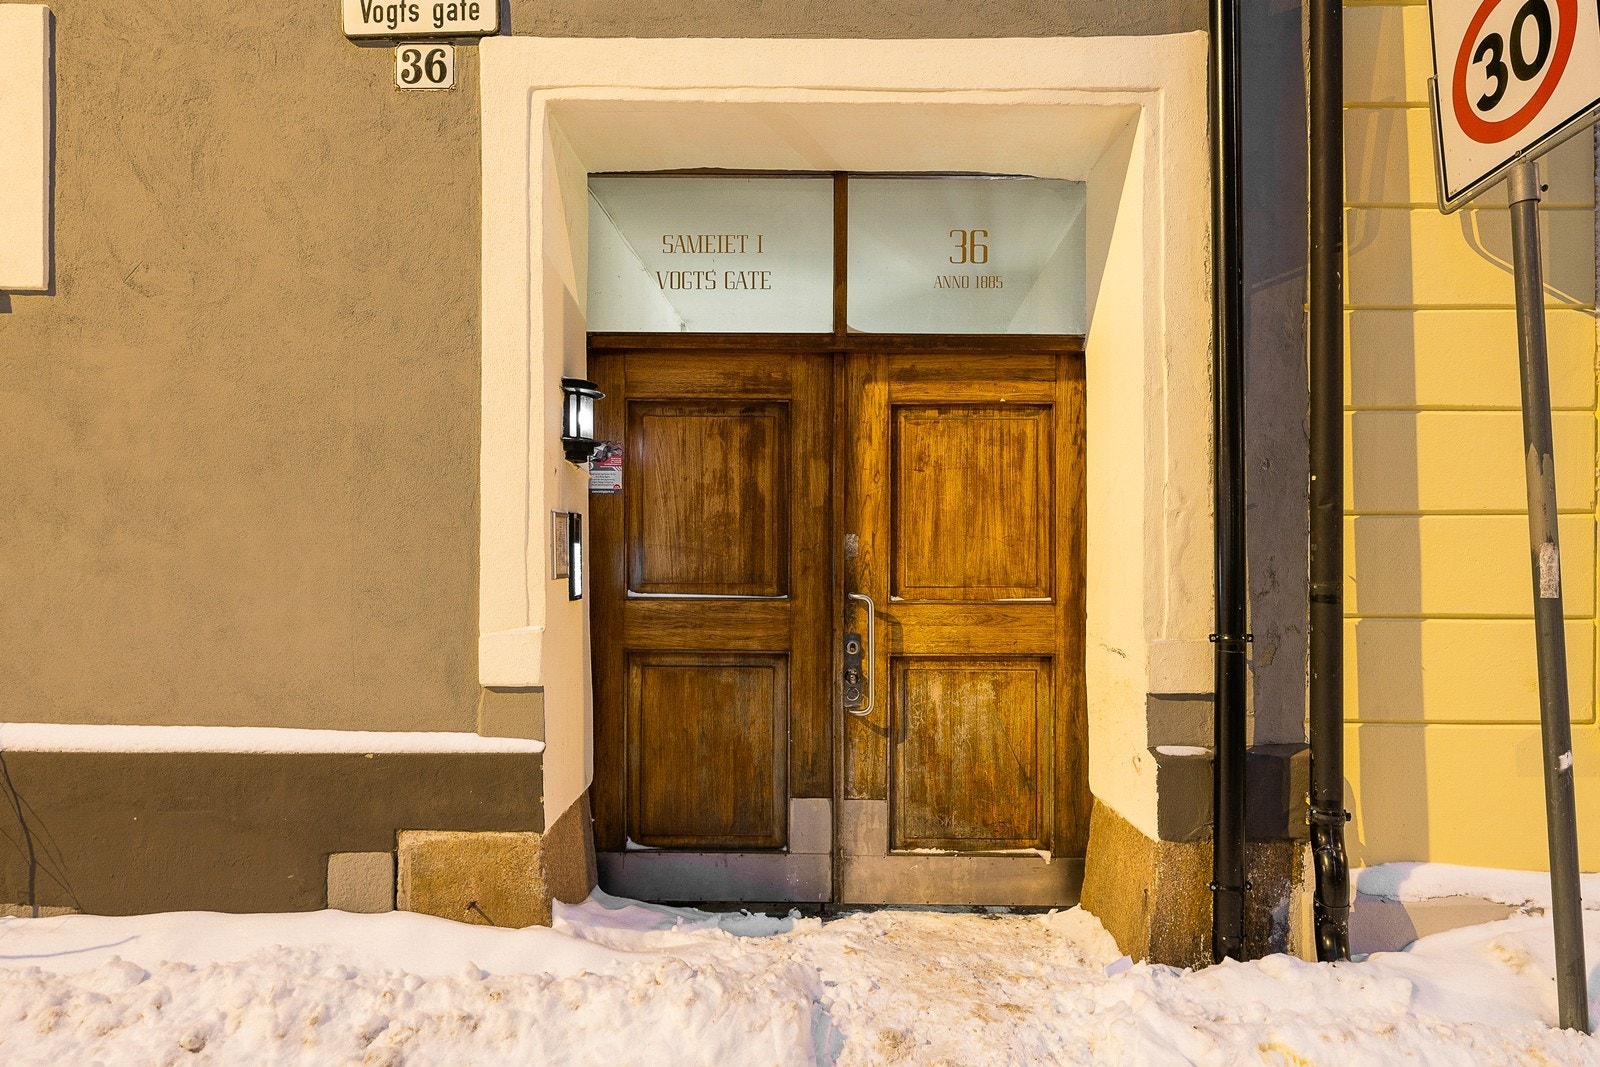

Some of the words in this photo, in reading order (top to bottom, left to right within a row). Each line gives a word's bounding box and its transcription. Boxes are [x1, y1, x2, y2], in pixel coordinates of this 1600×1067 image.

[360, 0, 420, 30] Vogts
[433, 0, 480, 29] gate
[401, 48, 448, 84] 36
[1472, 0, 1552, 112] 30
[662, 234, 749, 254] SAMEIET
[757, 234, 764, 254] I
[949, 229, 988, 264] 36
[656, 270, 717, 290] VOGTS
[724, 270, 772, 290] GATE
[933, 275, 970, 289] ANNO
[975, 275, 1004, 289] 1885
